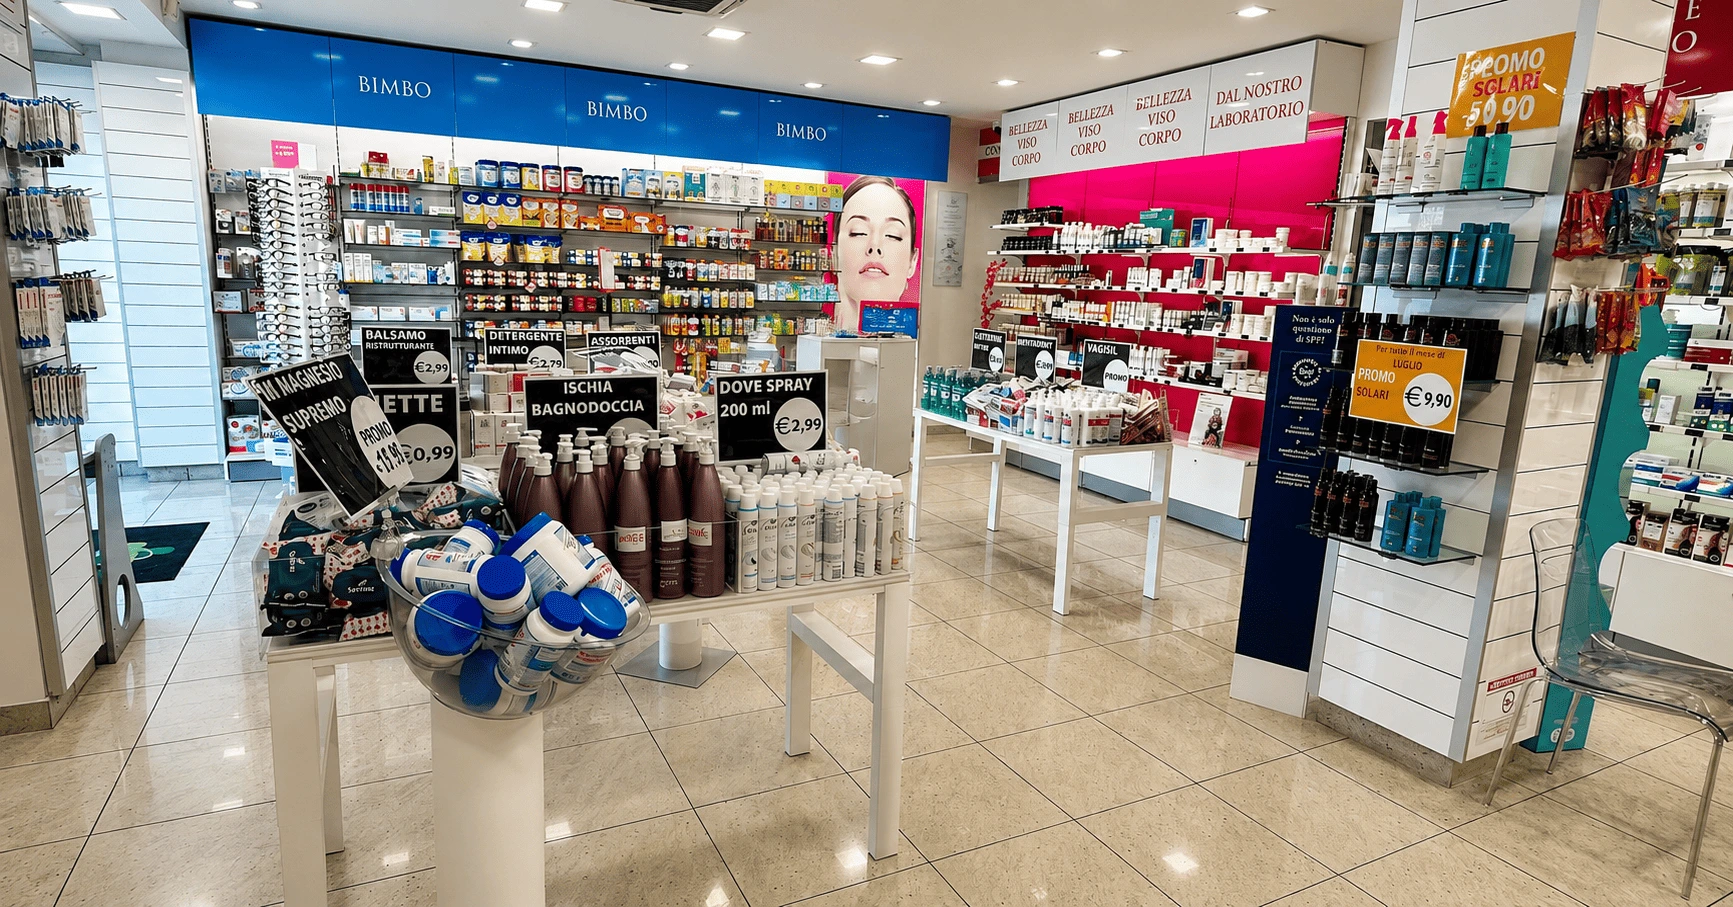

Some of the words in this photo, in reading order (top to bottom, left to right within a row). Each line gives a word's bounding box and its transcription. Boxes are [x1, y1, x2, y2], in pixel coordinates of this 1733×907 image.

[358, 75, 431, 99] BIMBO
[1216, 88, 1241, 105] DAL
[1244, 75, 1302, 101] NOSTRO
[1136, 87, 1192, 111] BELLEZZA
[587, 100, 648, 122] BIMBO
[1068, 104, 1114, 124] BELLEZZA
[1147, 109, 1176, 126] VISO
[1209, 100, 1304, 129] LABORATORIO
[776, 122, 827, 142] BIMBO
[1009, 119, 1048, 136] BELLEZZA
[1078, 123, 1101, 138] VISO
[1017, 136, 1037, 149] VISO
[1138, 127, 1182, 147] CORPO
[1070, 140, 1107, 157] CORPO
[1012, 152, 1041, 166] CORPO
[1292, 314, 1309, 323] Non
[365, 330, 426, 341] BALSAMO
[489, 331, 563, 342] DETERGENTE
[365, 342, 435, 350] RISTRUTTURANTE
[489, 345, 529, 355] INTIMO
[1087, 343, 1118, 355] VAGISIL
[1376, 344, 1388, 352] Per
[1389, 346, 1408, 355] tutto
[1409, 347, 1415, 355] il
[1437, 351, 1446, 359] di
[414, 361, 448, 374] €2,99
[1393, 359, 1422, 370] LUGLIO
[275, 361, 344, 396] MAGNESIO
[1105, 372, 1127, 382] PROMO
[1358, 367, 1396, 384] PROMO
[564, 380, 613, 394] ISCHIA
[720, 380, 762, 394] DOVE
[766, 377, 813, 393] SPRAY
[1356, 386, 1390, 400] SOLARI
[282, 395, 347, 434] SUPREMO
[531, 399, 644, 416] BAGNODOCCIA
[720, 402, 748, 417] 200
[752, 400, 771, 416] ml
[359, 420, 392, 447] PROMO
[775, 416, 822, 435] €2,99
